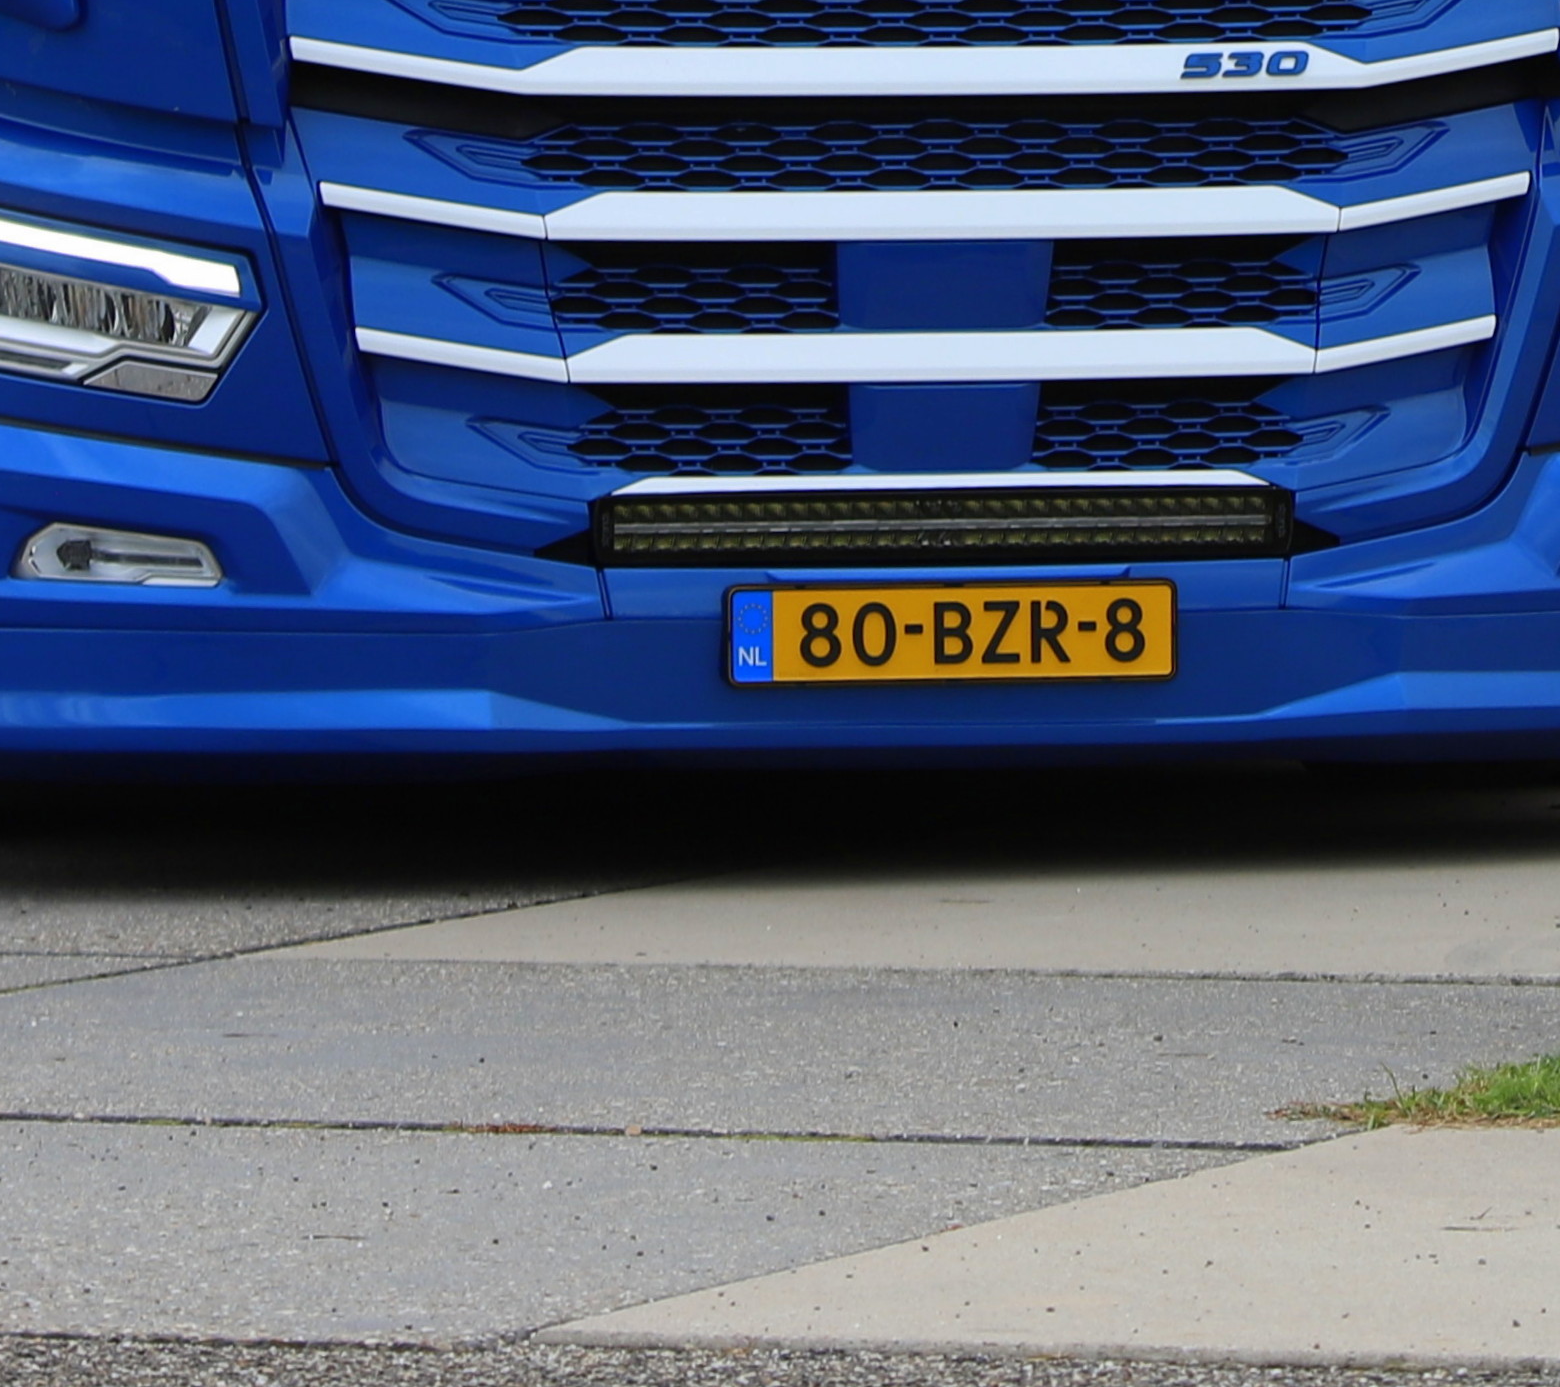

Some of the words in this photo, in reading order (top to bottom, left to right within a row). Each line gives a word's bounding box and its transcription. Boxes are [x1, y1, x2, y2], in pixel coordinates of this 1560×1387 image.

[1180, 50, 1309, 79] 530
[738, 647, 766, 667] NL
[798, 598, 1146, 668] 80-BZR-8
